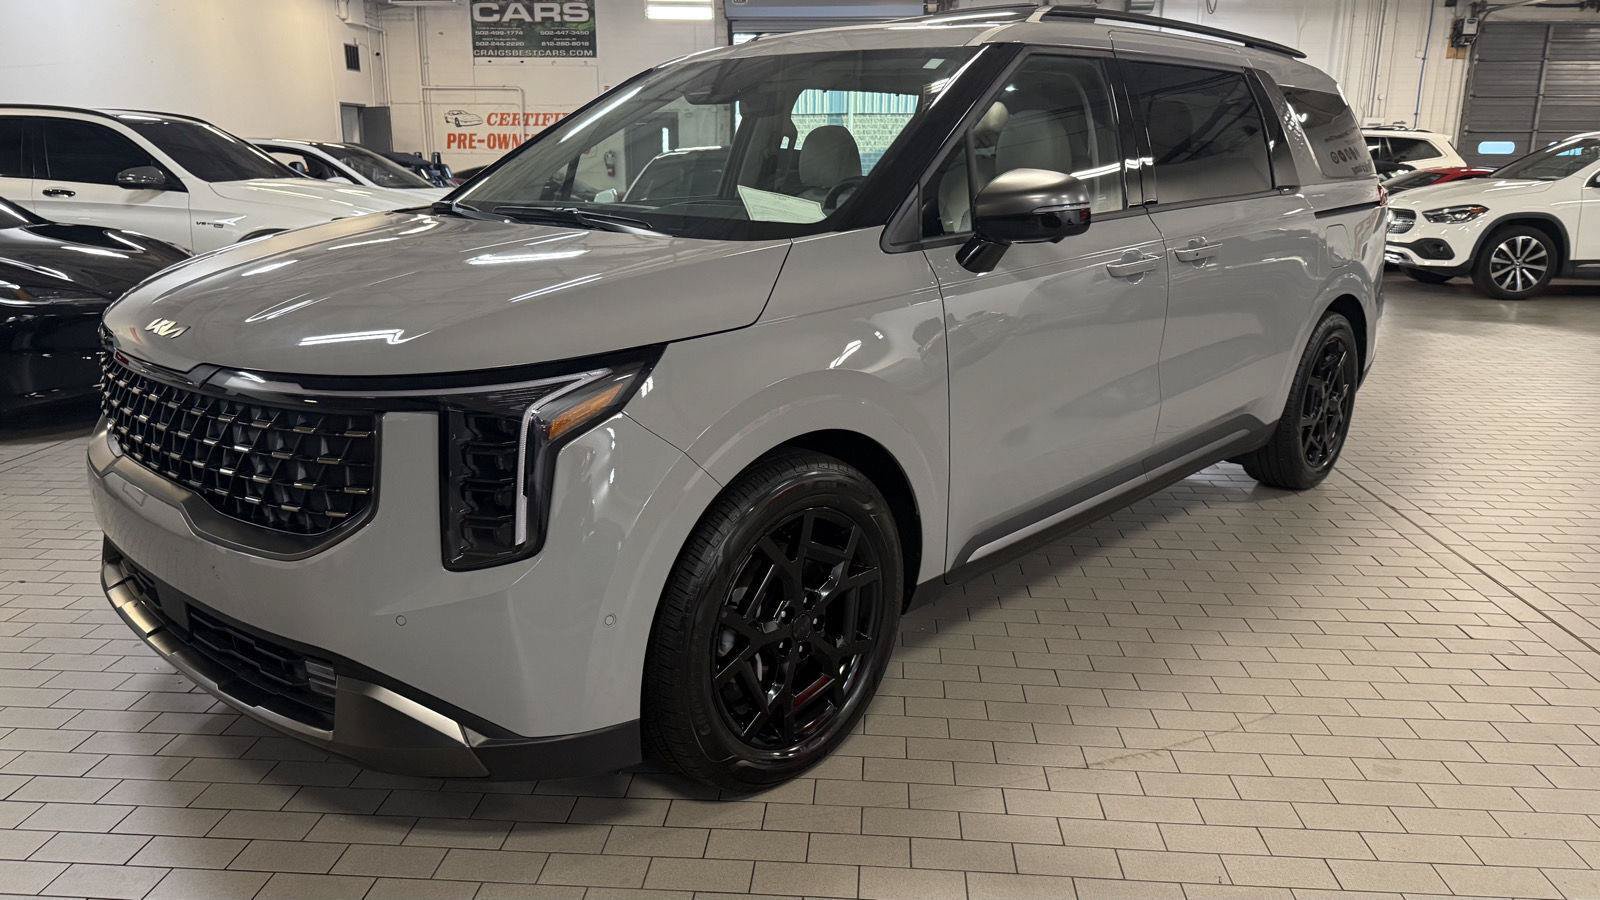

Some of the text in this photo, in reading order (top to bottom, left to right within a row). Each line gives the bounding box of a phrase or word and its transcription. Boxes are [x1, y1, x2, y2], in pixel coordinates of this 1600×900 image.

[473, 2, 590, 22] CARS
[474, 49, 593, 57] CRAIGSBESTCARS.COM
[487, 112, 569, 126] CERTIFI
